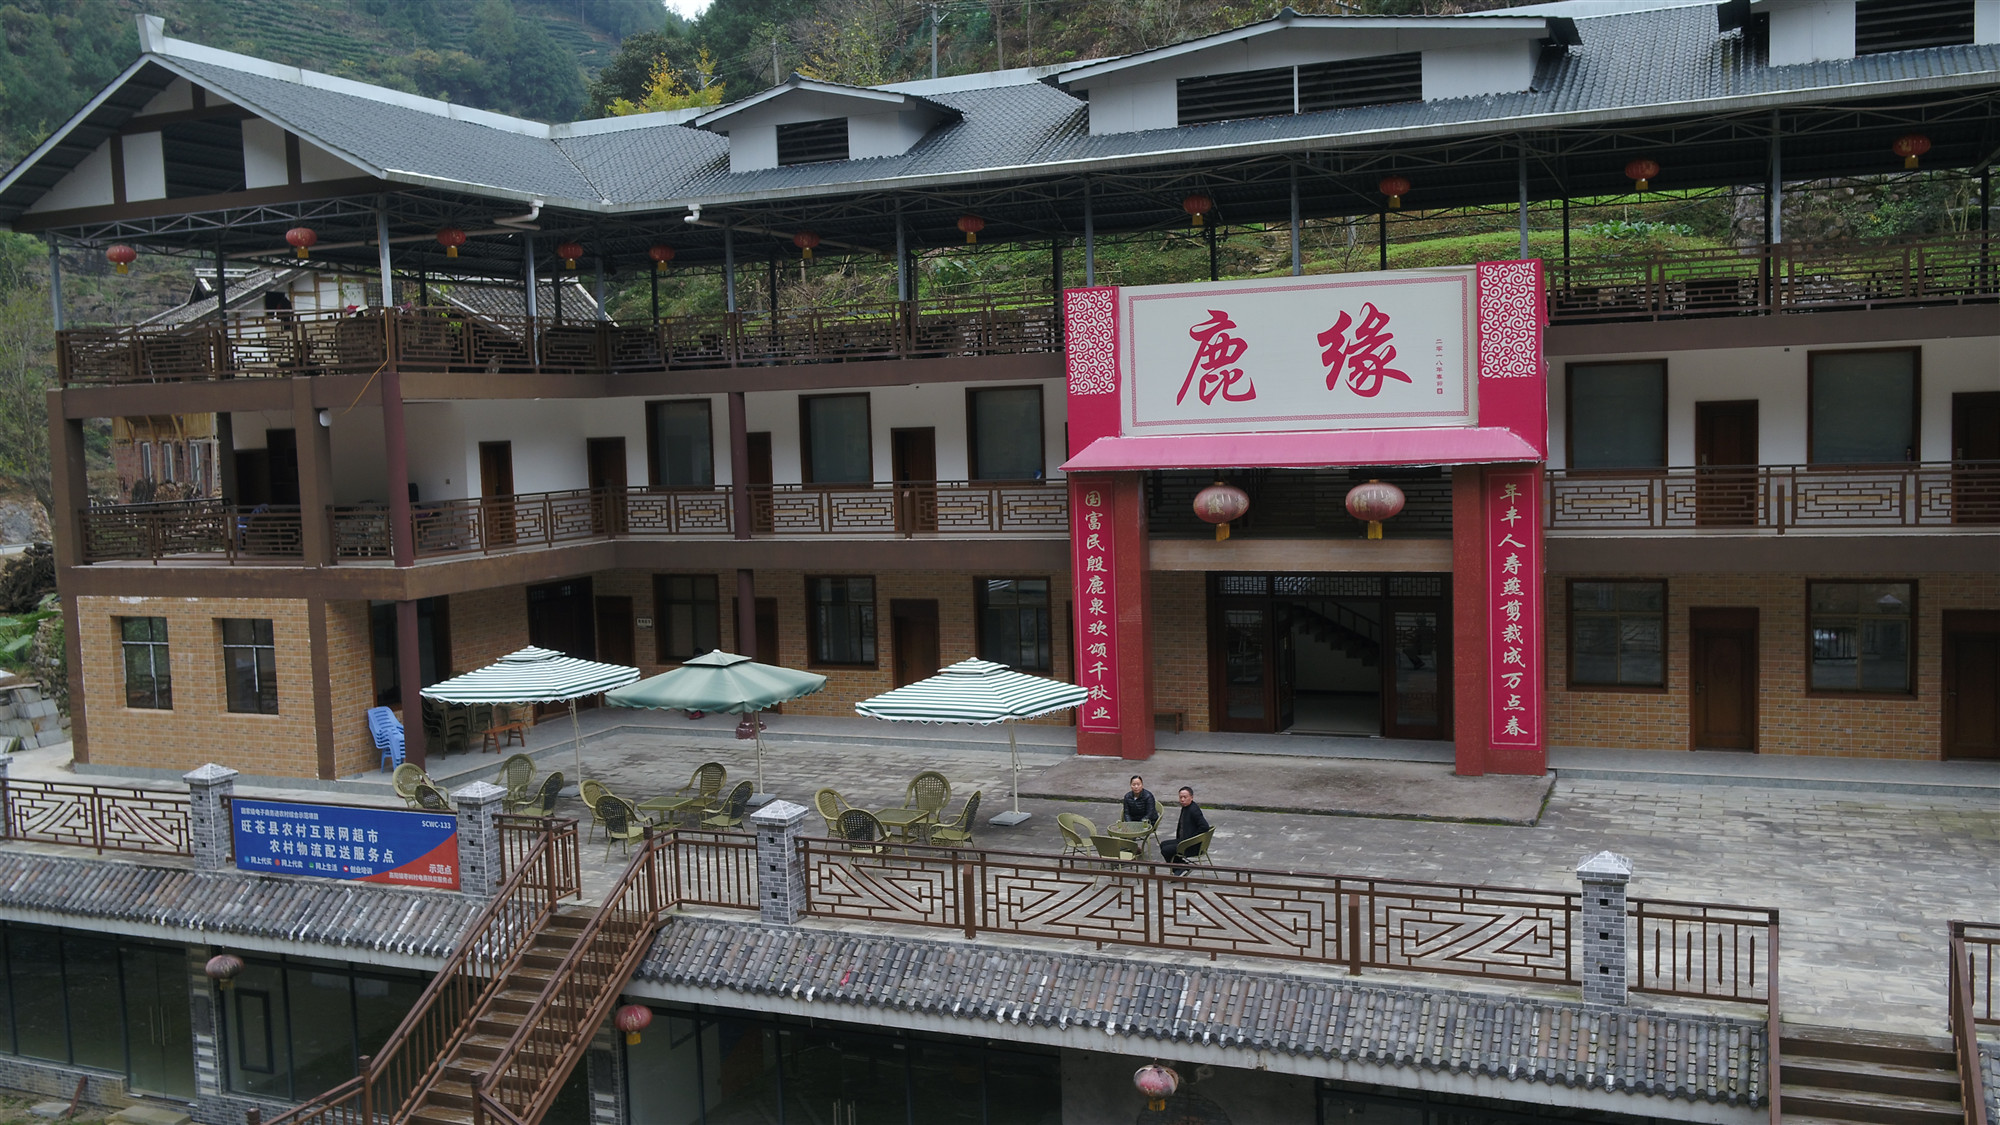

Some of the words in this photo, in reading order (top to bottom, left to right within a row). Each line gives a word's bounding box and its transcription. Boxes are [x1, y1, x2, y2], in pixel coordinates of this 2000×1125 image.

[1177, 302, 1412, 405] 鹿缘
[1085, 491, 1112, 720] 国富民殷鹿泉欢颂千秋业
[1497, 483, 1526, 737] 年丰人寿燕剪裁成万点春
[241, 819, 379, 844] 旺苍县农村互联网超市
[422, 820, 451, 829] SCWC-133
[269, 839, 395, 864] 农村物流配送服务点
[250, 856, 272, 866] 网上代买
[315, 862, 338, 872] 网上生活
[349, 865, 373, 875] 创业培训
[429, 863, 452, 875] 示范点
